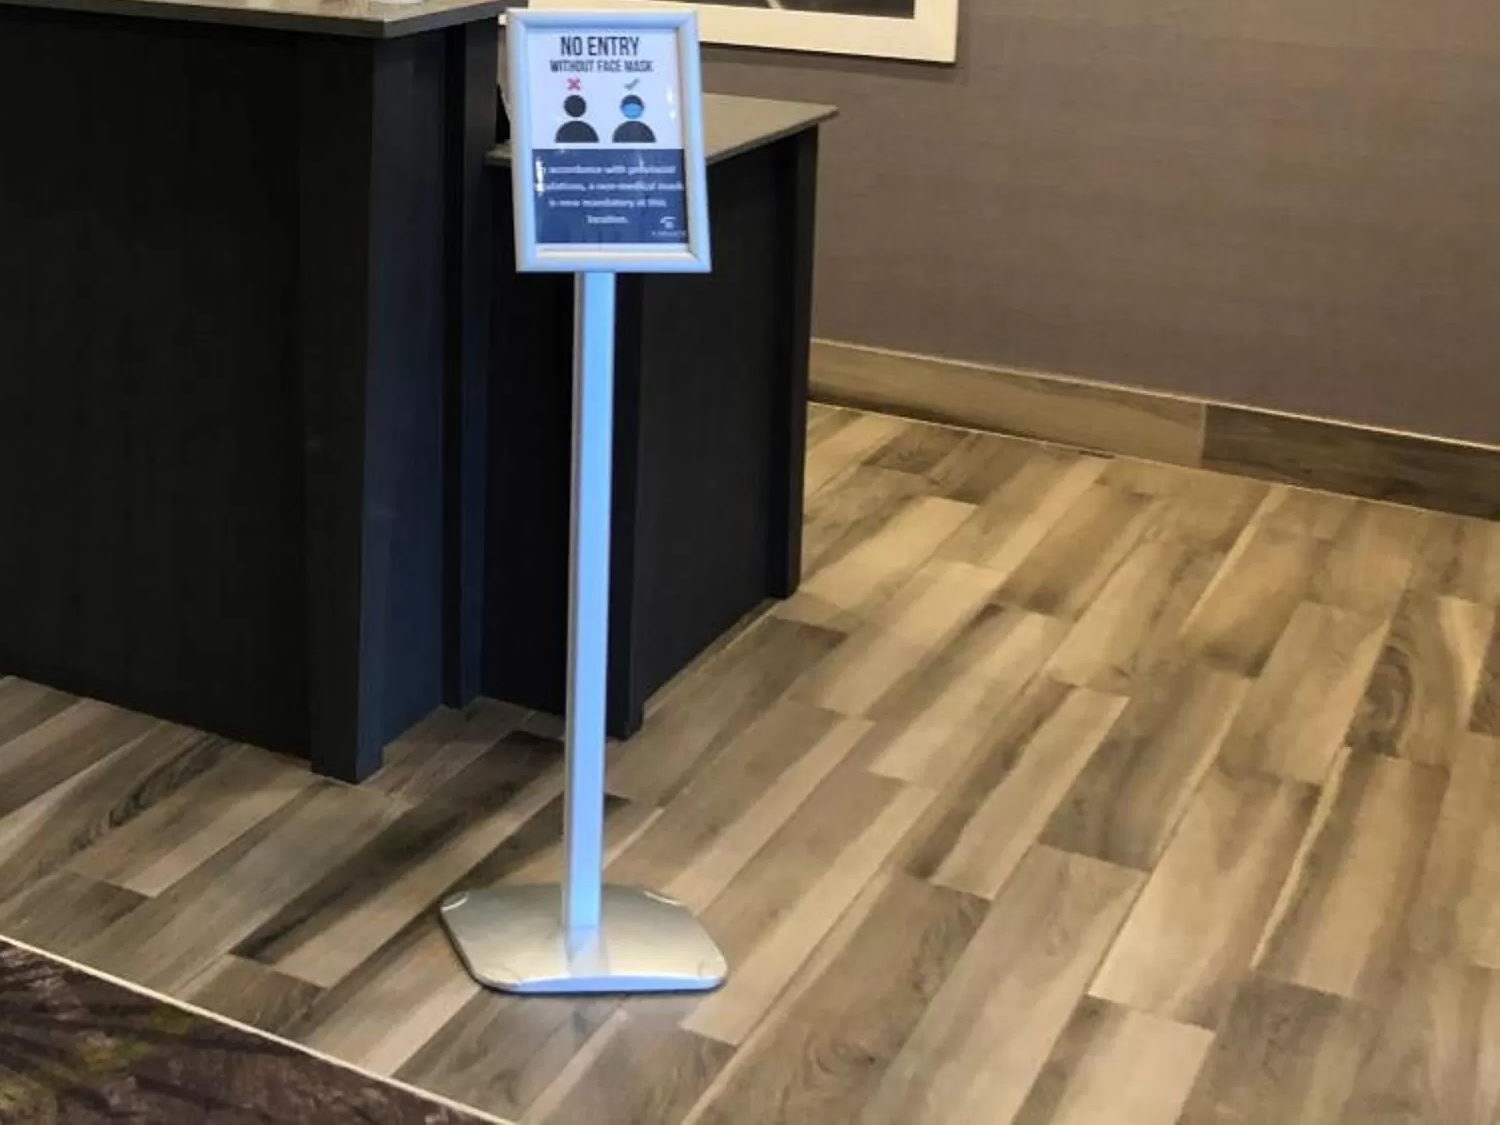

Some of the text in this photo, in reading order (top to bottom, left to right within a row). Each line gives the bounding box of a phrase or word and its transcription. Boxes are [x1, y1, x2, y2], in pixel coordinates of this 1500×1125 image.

[560, 36, 640, 56] NO ENTRY
[549, 59, 654, 73] WITHOUT FACE MASK
